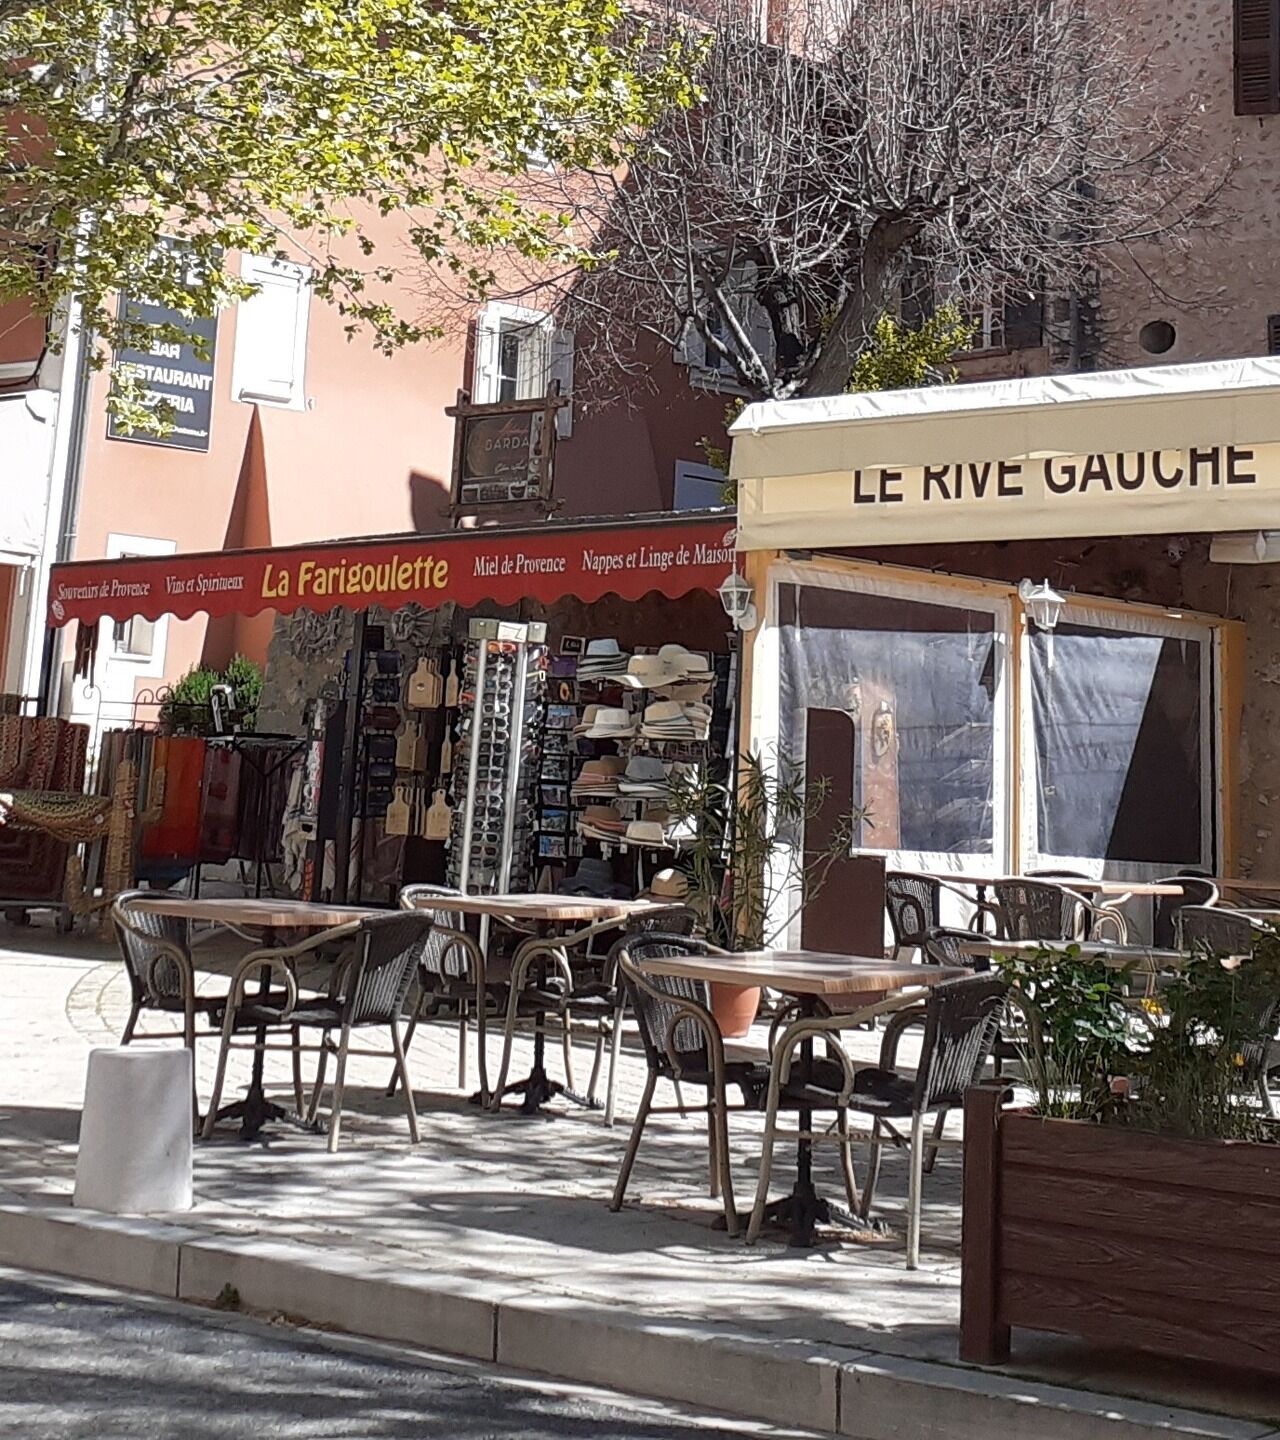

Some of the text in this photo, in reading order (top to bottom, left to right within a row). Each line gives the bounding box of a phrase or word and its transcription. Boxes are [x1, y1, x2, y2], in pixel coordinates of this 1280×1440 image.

[853, 446, 1257, 504] LE RIVE GAUCHE
[58, 542, 737, 601] Souvenirs de Provence Vins et Spiritueux La Farigoulette Miel de Provence Nappes et Linge de Maison
